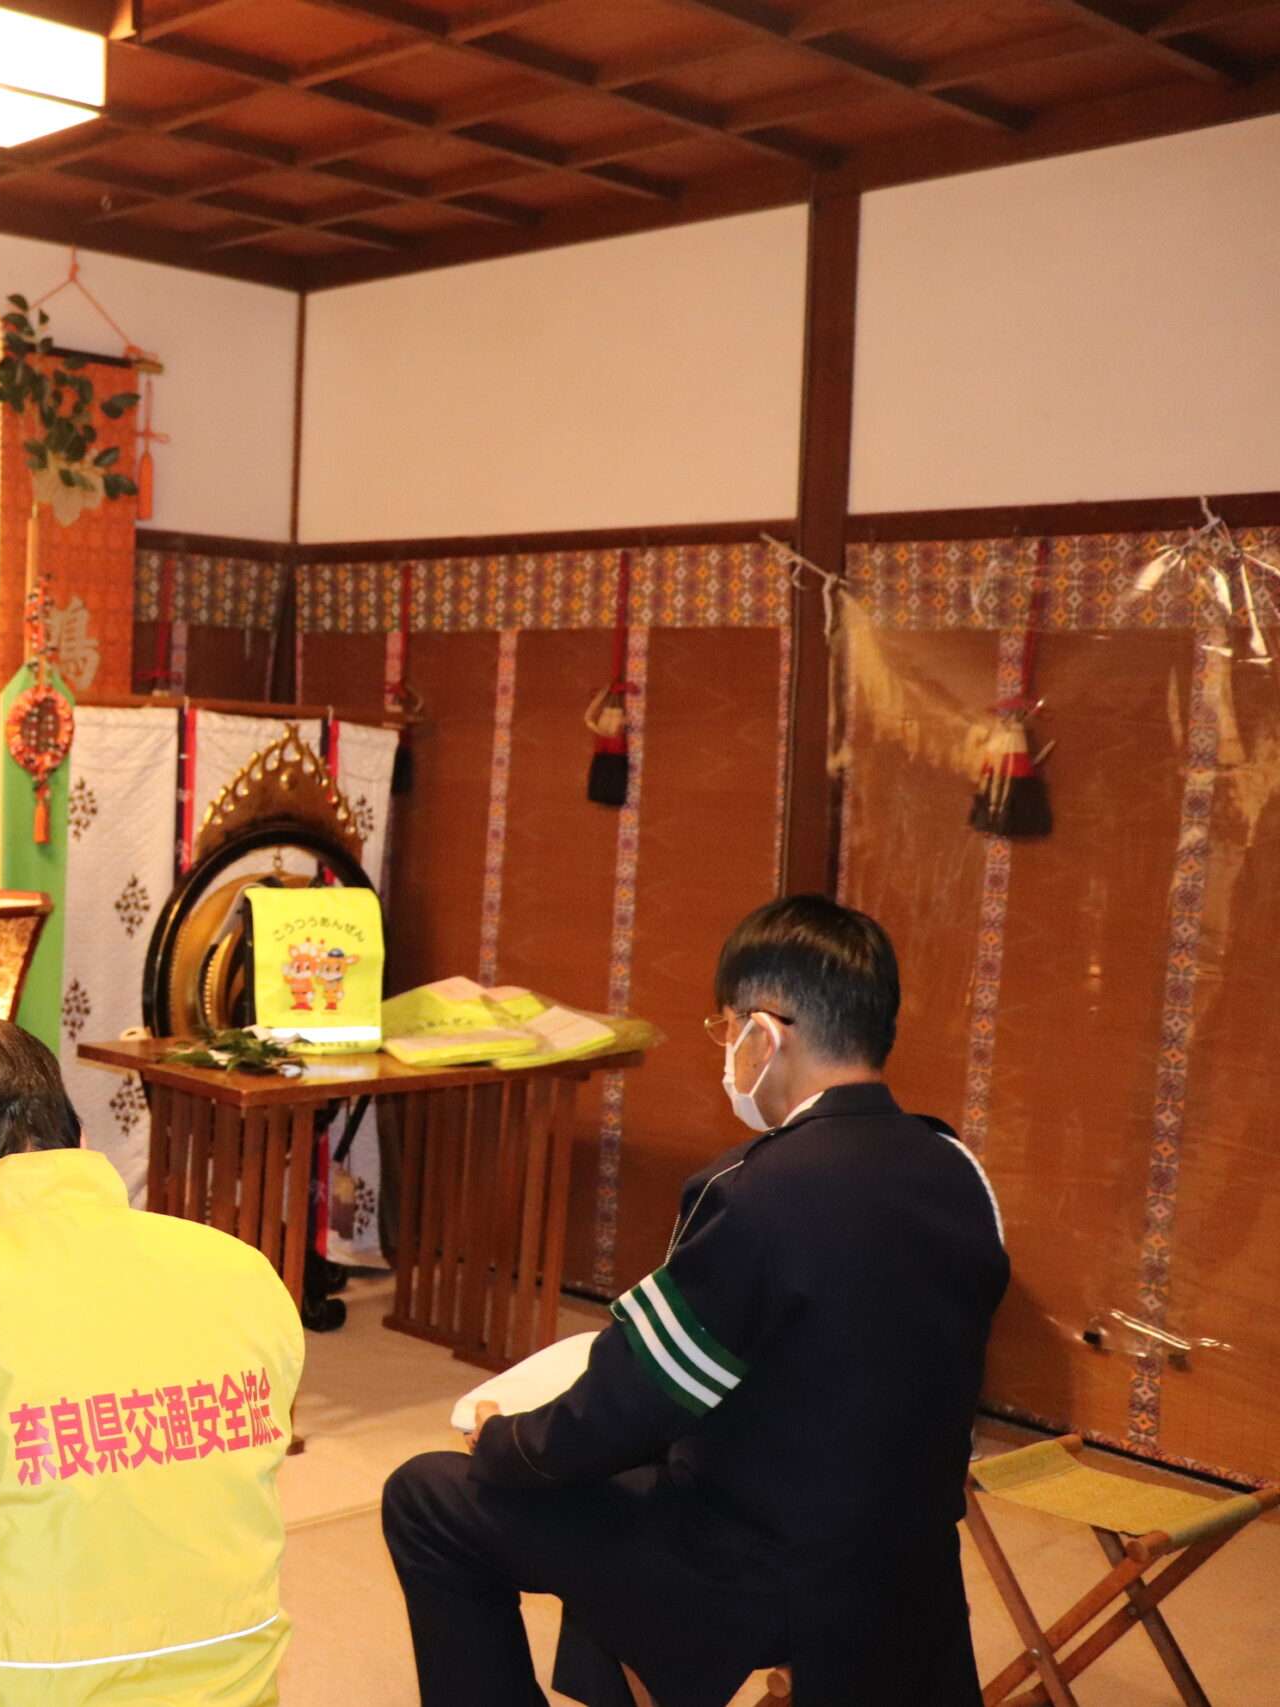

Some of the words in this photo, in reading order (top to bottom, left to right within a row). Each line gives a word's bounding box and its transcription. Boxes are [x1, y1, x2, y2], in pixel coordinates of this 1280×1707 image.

[273, 916, 366, 943] こうつうあんぜん
